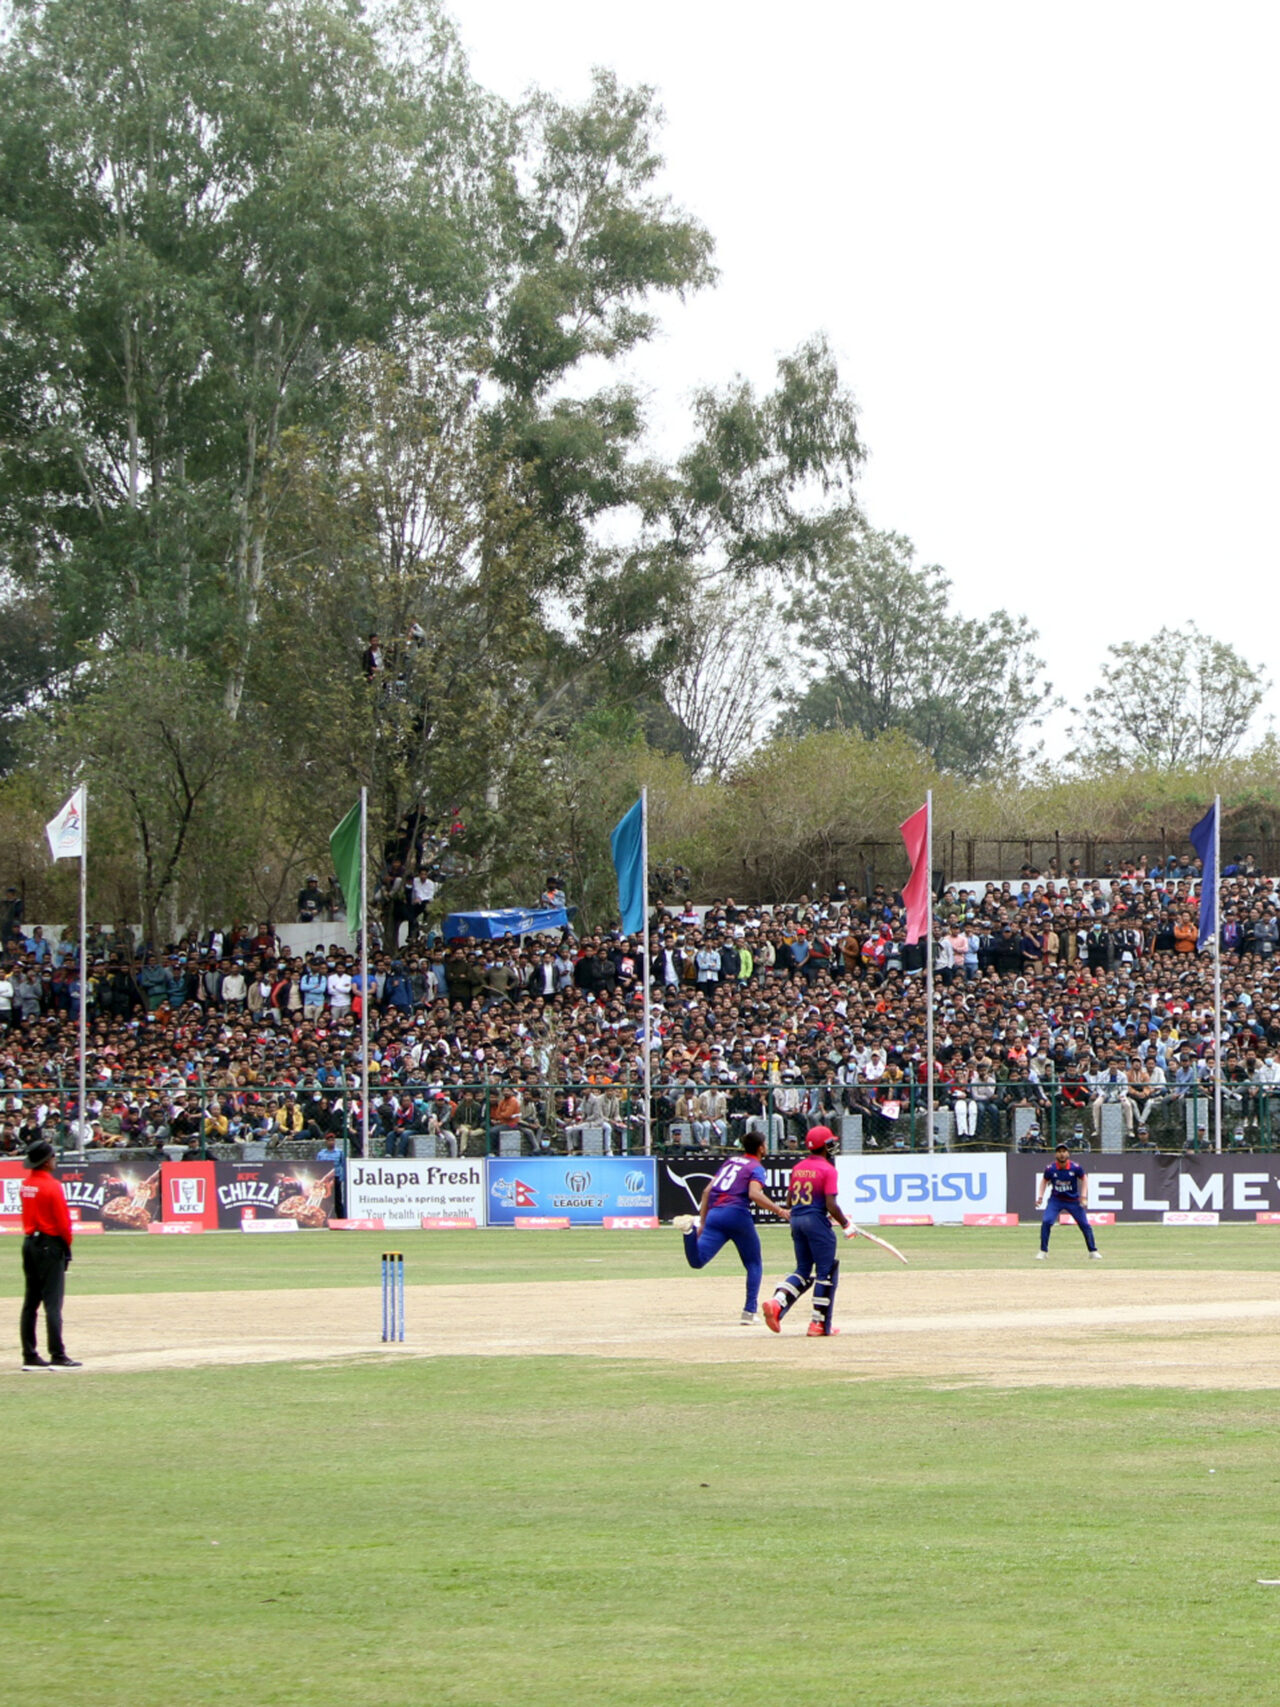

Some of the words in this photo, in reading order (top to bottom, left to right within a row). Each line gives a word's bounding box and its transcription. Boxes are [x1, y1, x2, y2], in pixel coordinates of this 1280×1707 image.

[353, 1167, 419, 1189] Jalapa
[427, 1167, 480, 1185] Fresh
[713, 1164, 742, 1191] 15
[62, 1182, 104, 1206] IZZA
[218, 1181, 280, 1205] CHIZZA
[554, 1199, 593, 1208] LEAGUE
[597, 1199, 603, 1208] 2
[792, 1181, 813, 1206] 33
[611, 1218, 652, 1229] KFC
